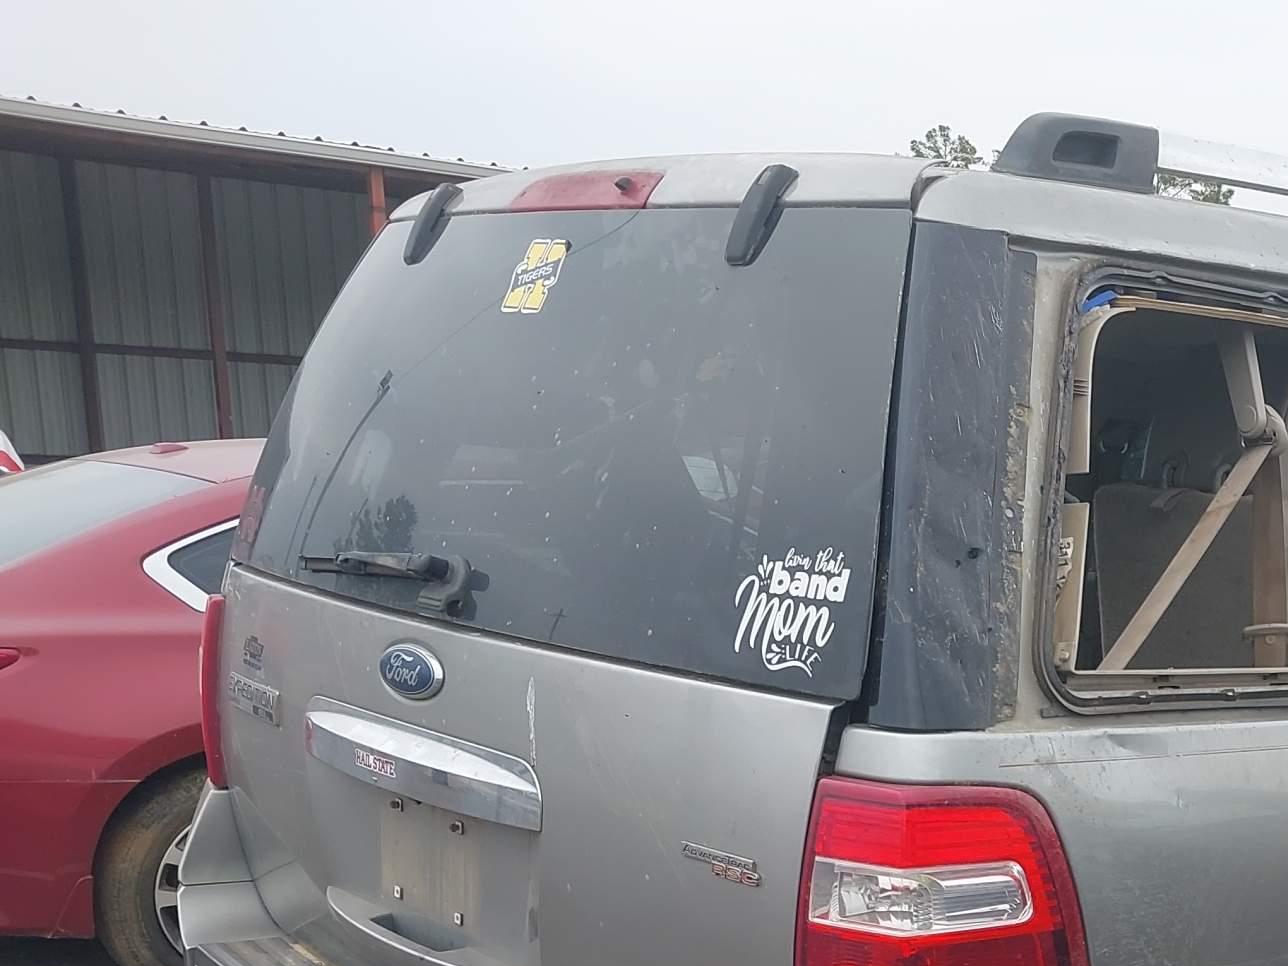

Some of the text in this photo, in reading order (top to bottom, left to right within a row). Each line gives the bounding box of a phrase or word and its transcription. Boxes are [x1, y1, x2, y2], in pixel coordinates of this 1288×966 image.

[517, 263, 554, 285] TIGERS
[784, 547, 845, 575] livin that
[769, 560, 851, 602] band
[734, 574, 835, 678] Mom
[785, 643, 822, 671] LIFE
[229, 674, 274, 711] EXPEDITION
[355, 749, 396, 777] HAIL STATE
[711, 861, 762, 887] RSC
